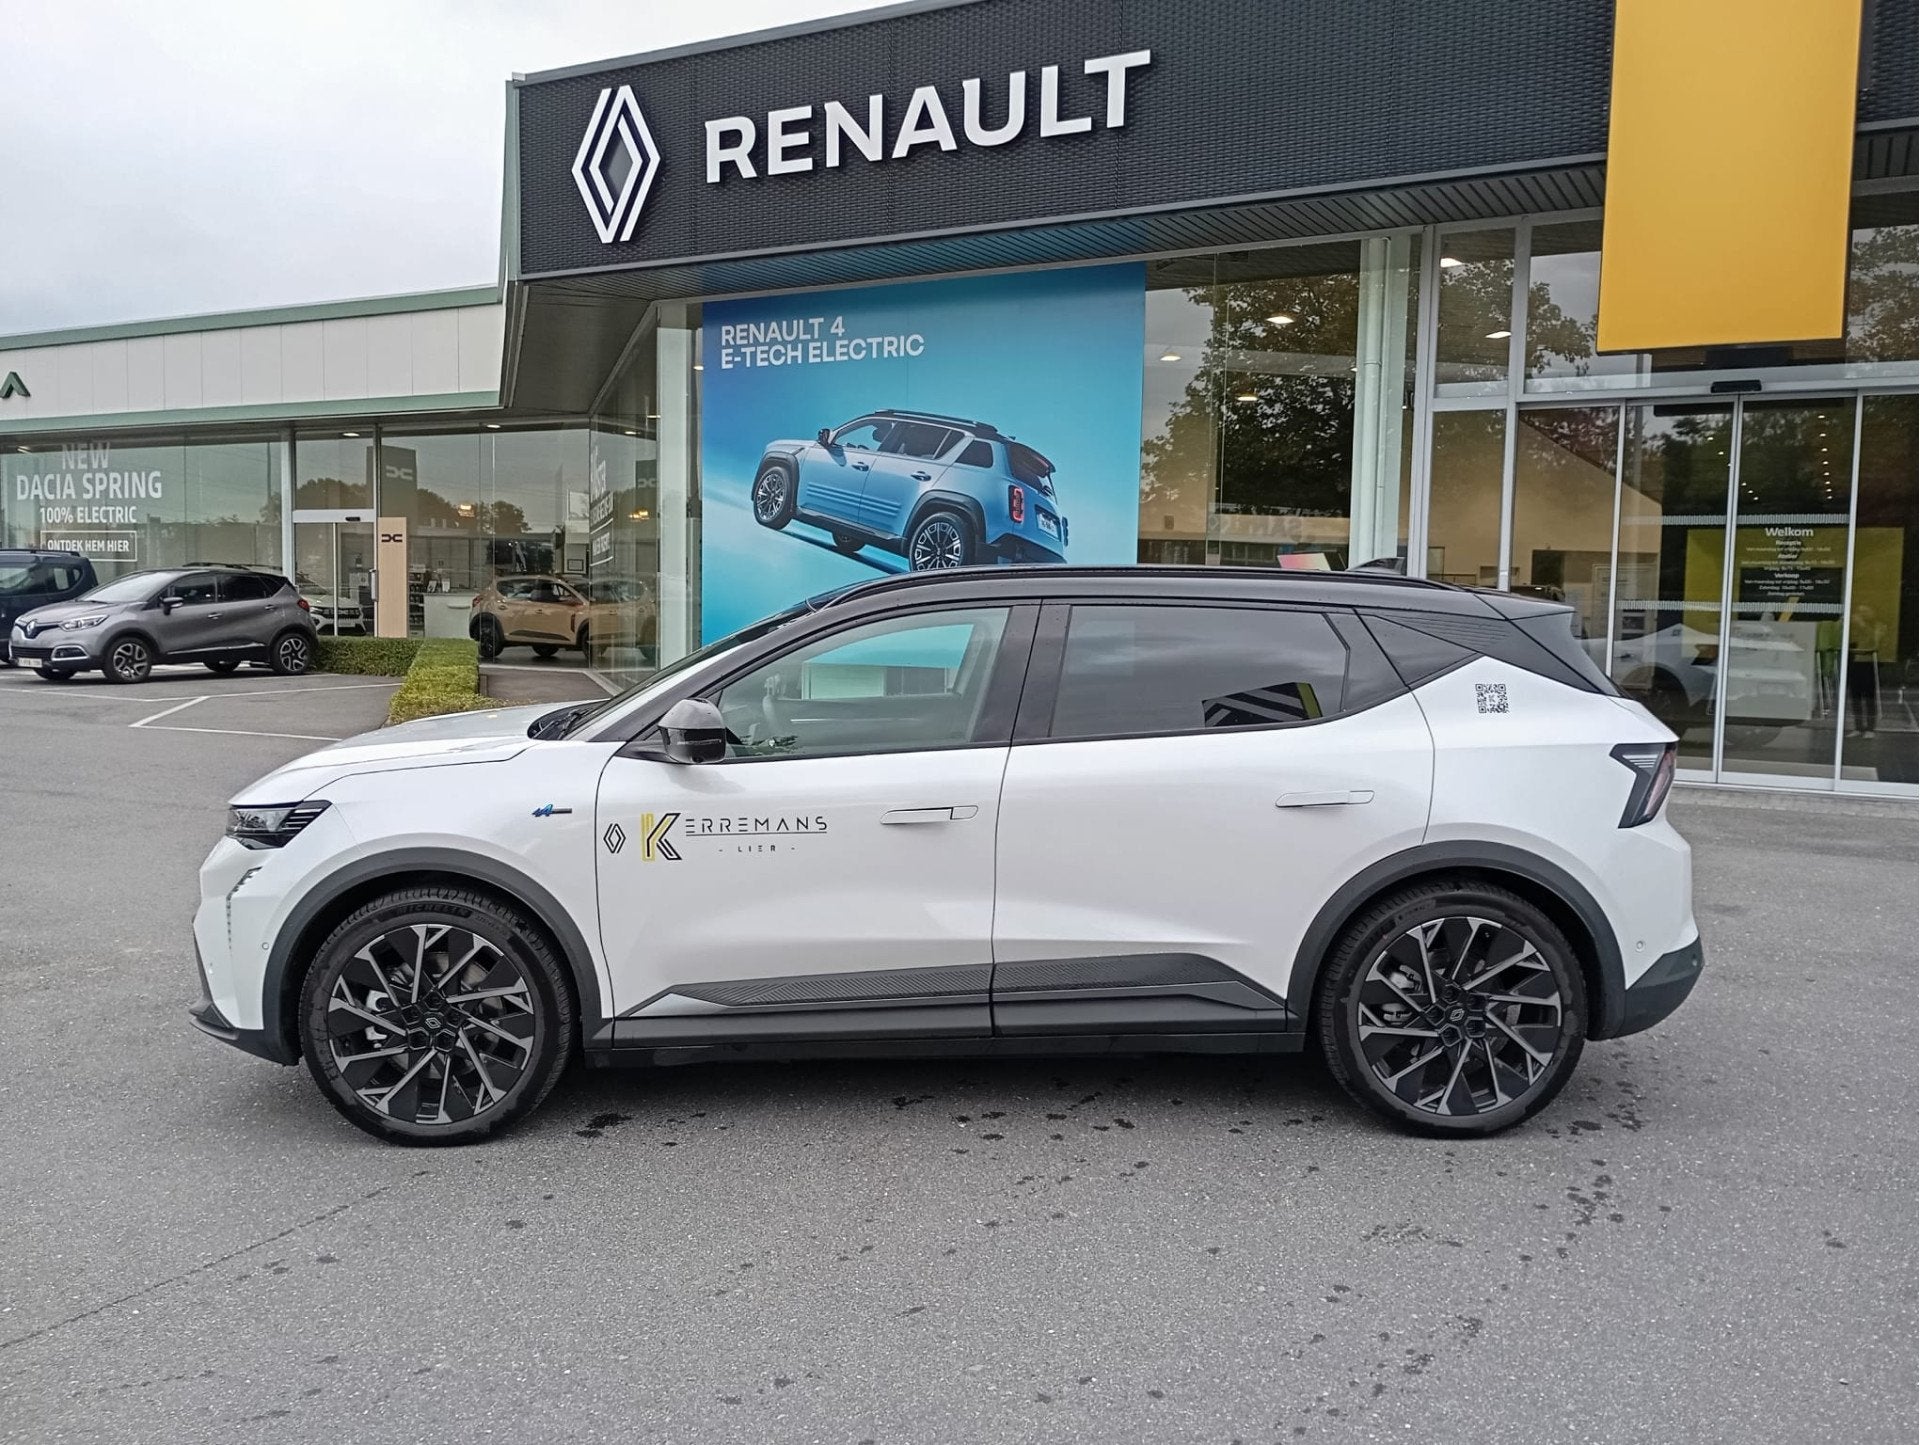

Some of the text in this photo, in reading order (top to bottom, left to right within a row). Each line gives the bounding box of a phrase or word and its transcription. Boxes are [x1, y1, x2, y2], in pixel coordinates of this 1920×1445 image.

[705, 49, 1151, 184] RENAULT
[721, 316, 845, 346] RENAULT 4
[721, 334, 925, 369] E-TECH ELECTRIC
[62, 442, 110, 470] NEW
[16, 470, 162, 501] DACIA SPRING
[40, 505, 137, 524] 100% ELECTRIC
[1764, 526, 1814, 537] Welkom
[47, 540, 129, 552] ONTDEK HEM HIER
[737, 845, 776, 853] LIER
